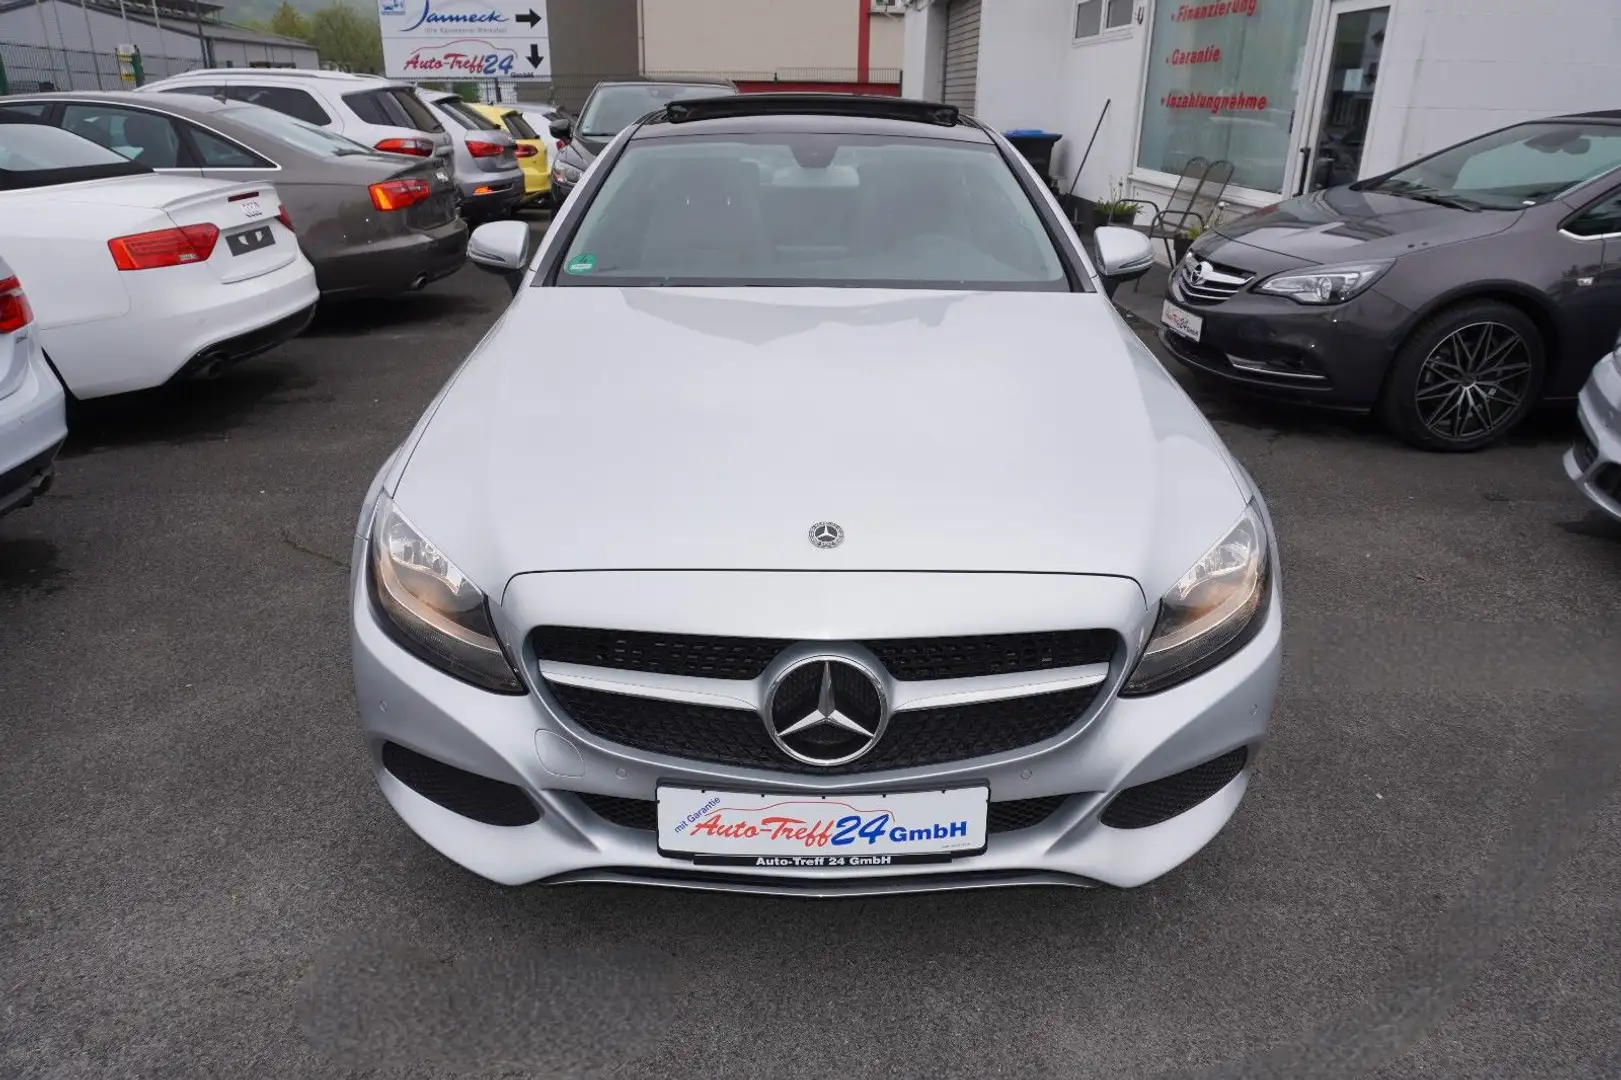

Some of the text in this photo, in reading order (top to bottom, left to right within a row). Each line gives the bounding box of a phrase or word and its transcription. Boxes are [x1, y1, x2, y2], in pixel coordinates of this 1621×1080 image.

[1176, 0, 1258, 23] Finanzierung
[1172, 45, 1221, 65] Garantie
[1166, 92, 1268, 115] Inzahlungnahme
[674, 797, 721, 834] mit Garantie
[889, 821, 967, 842] GmbH
[756, 856, 891, 866] Auto-Treff 24 GmbH
